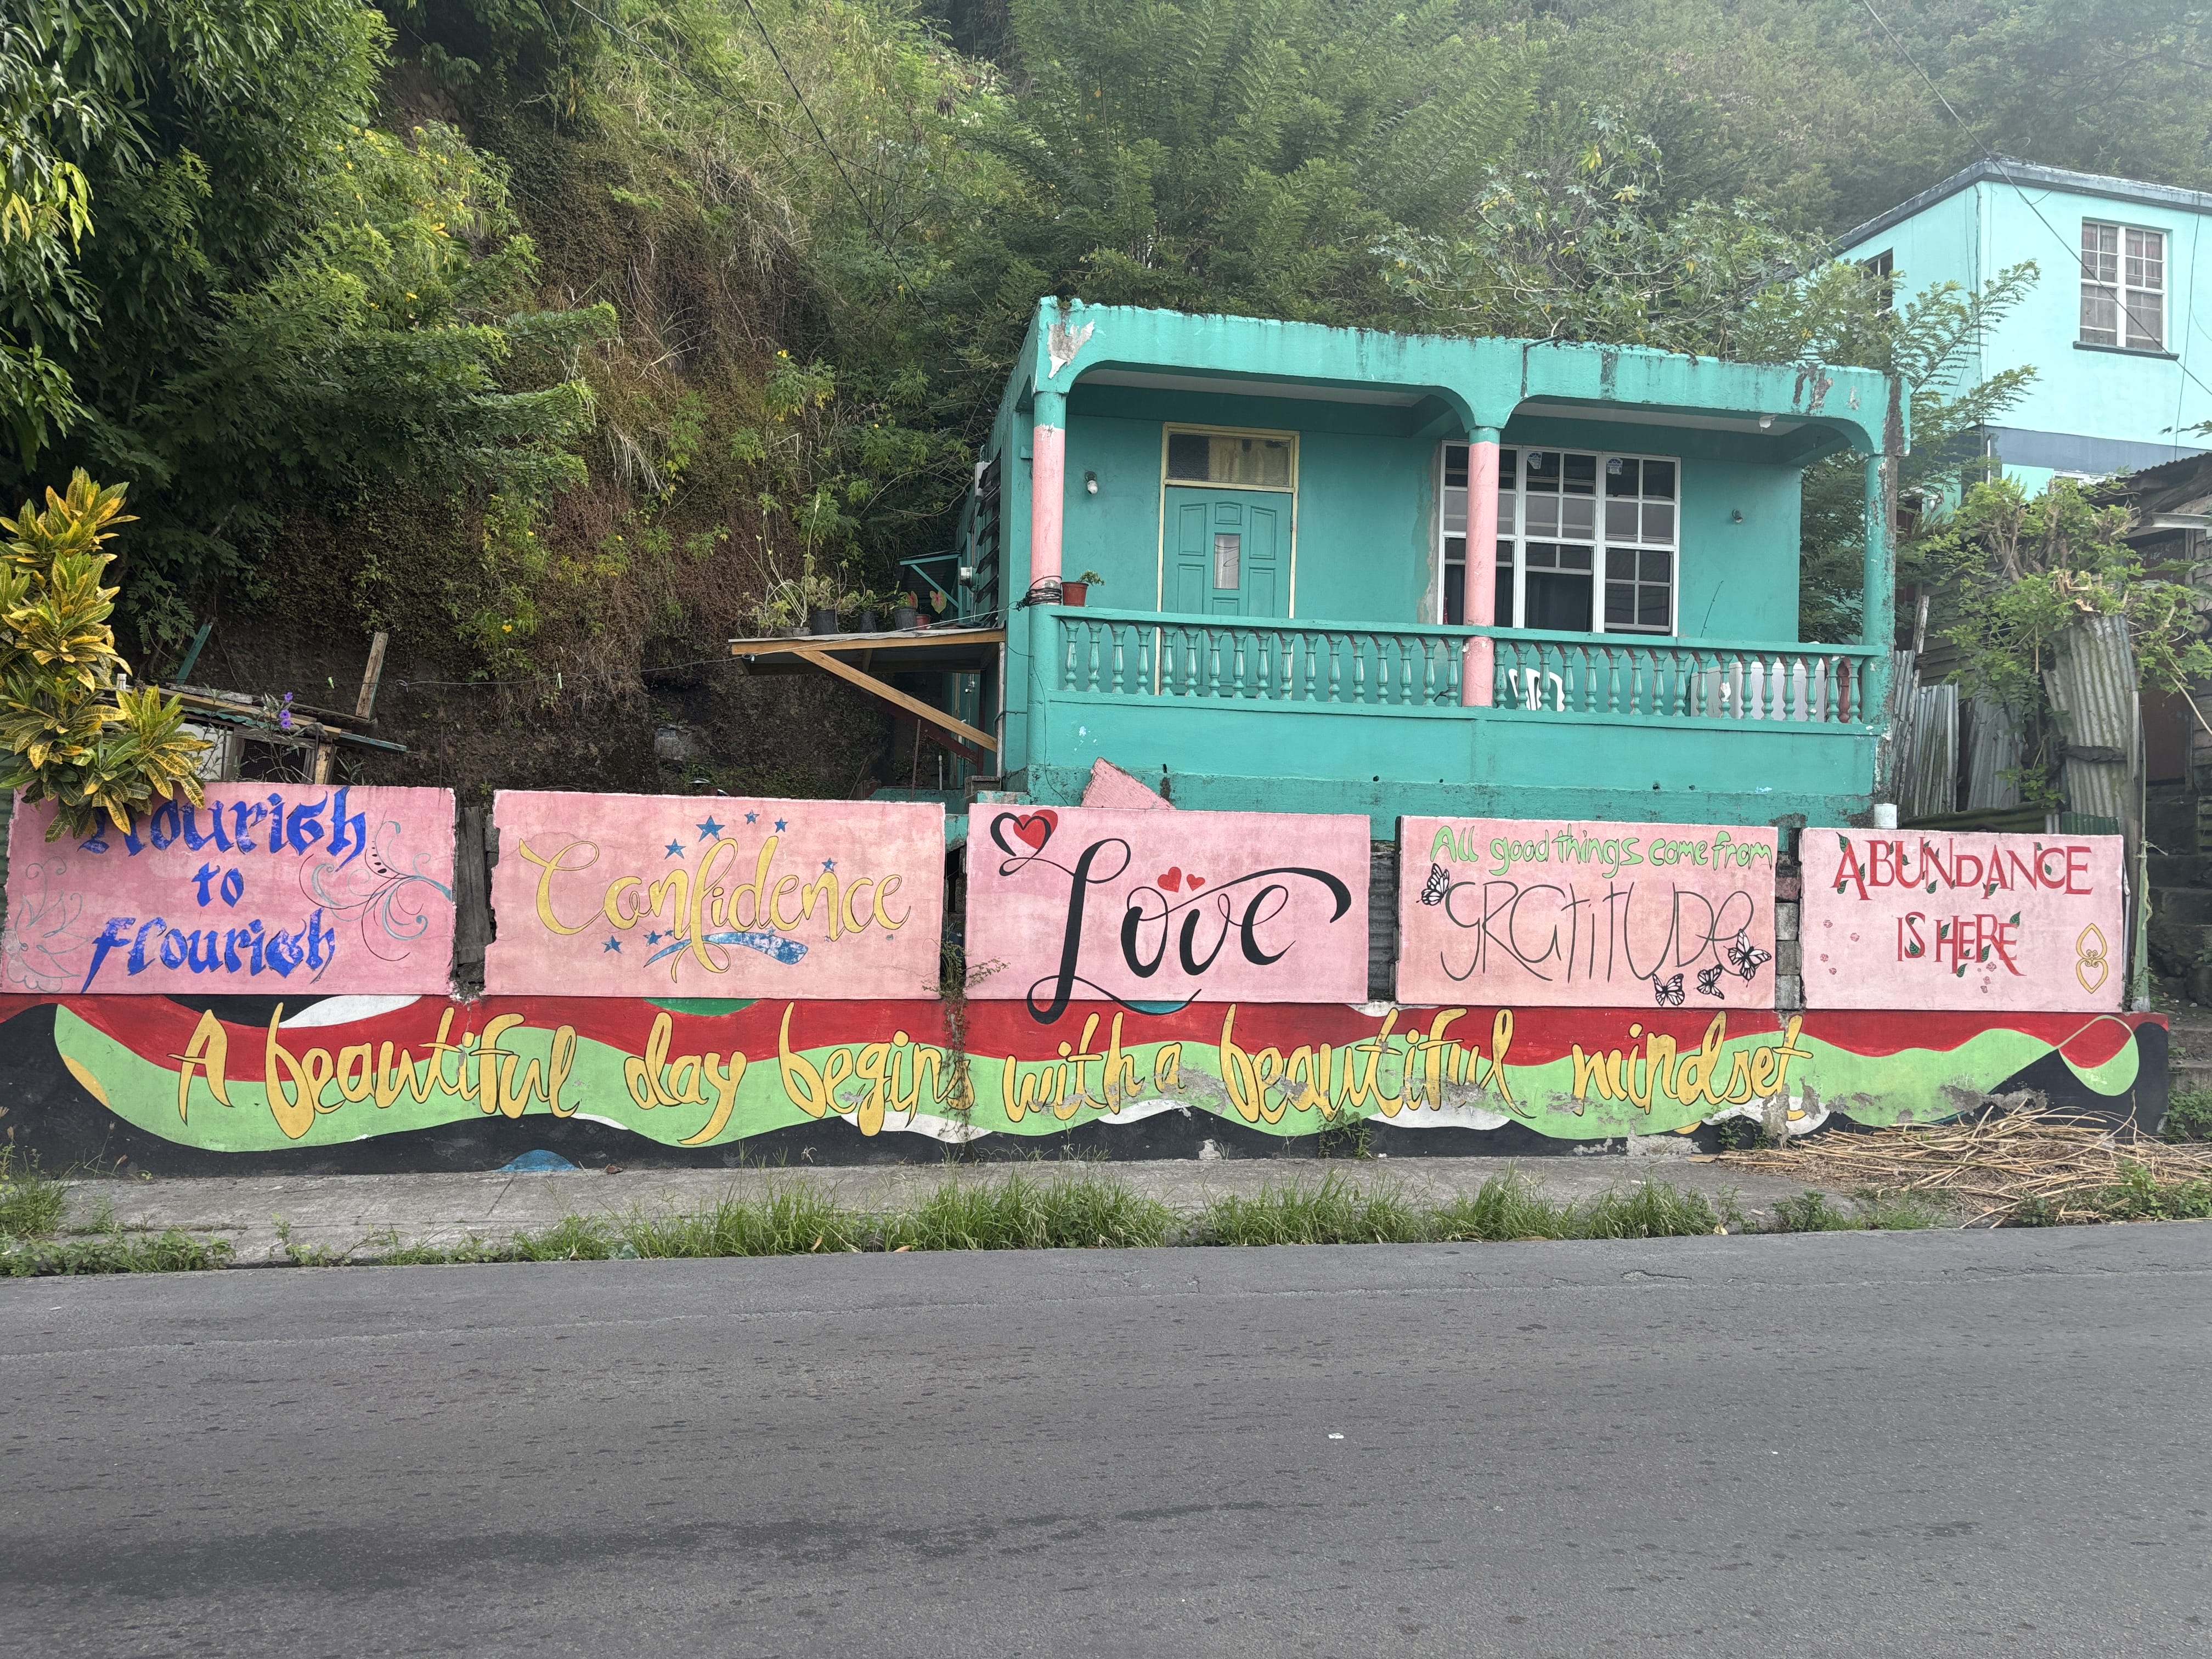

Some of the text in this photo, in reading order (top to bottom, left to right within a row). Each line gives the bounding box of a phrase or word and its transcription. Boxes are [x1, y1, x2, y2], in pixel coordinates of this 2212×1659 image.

[192, 862, 245, 907] to
[1430, 823, 1773, 878] All good things come from
[1830, 837, 2094, 900] ABUNDANCE
[519, 836, 911, 983] Confidence
[990, 812, 1351, 1024] Love
[1896, 911, 2027, 976] IS HERE
[81, 907, 336, 993] Flourish
[167, 1002, 1813, 1146] A beautiful day begins with a beautiful mindset
